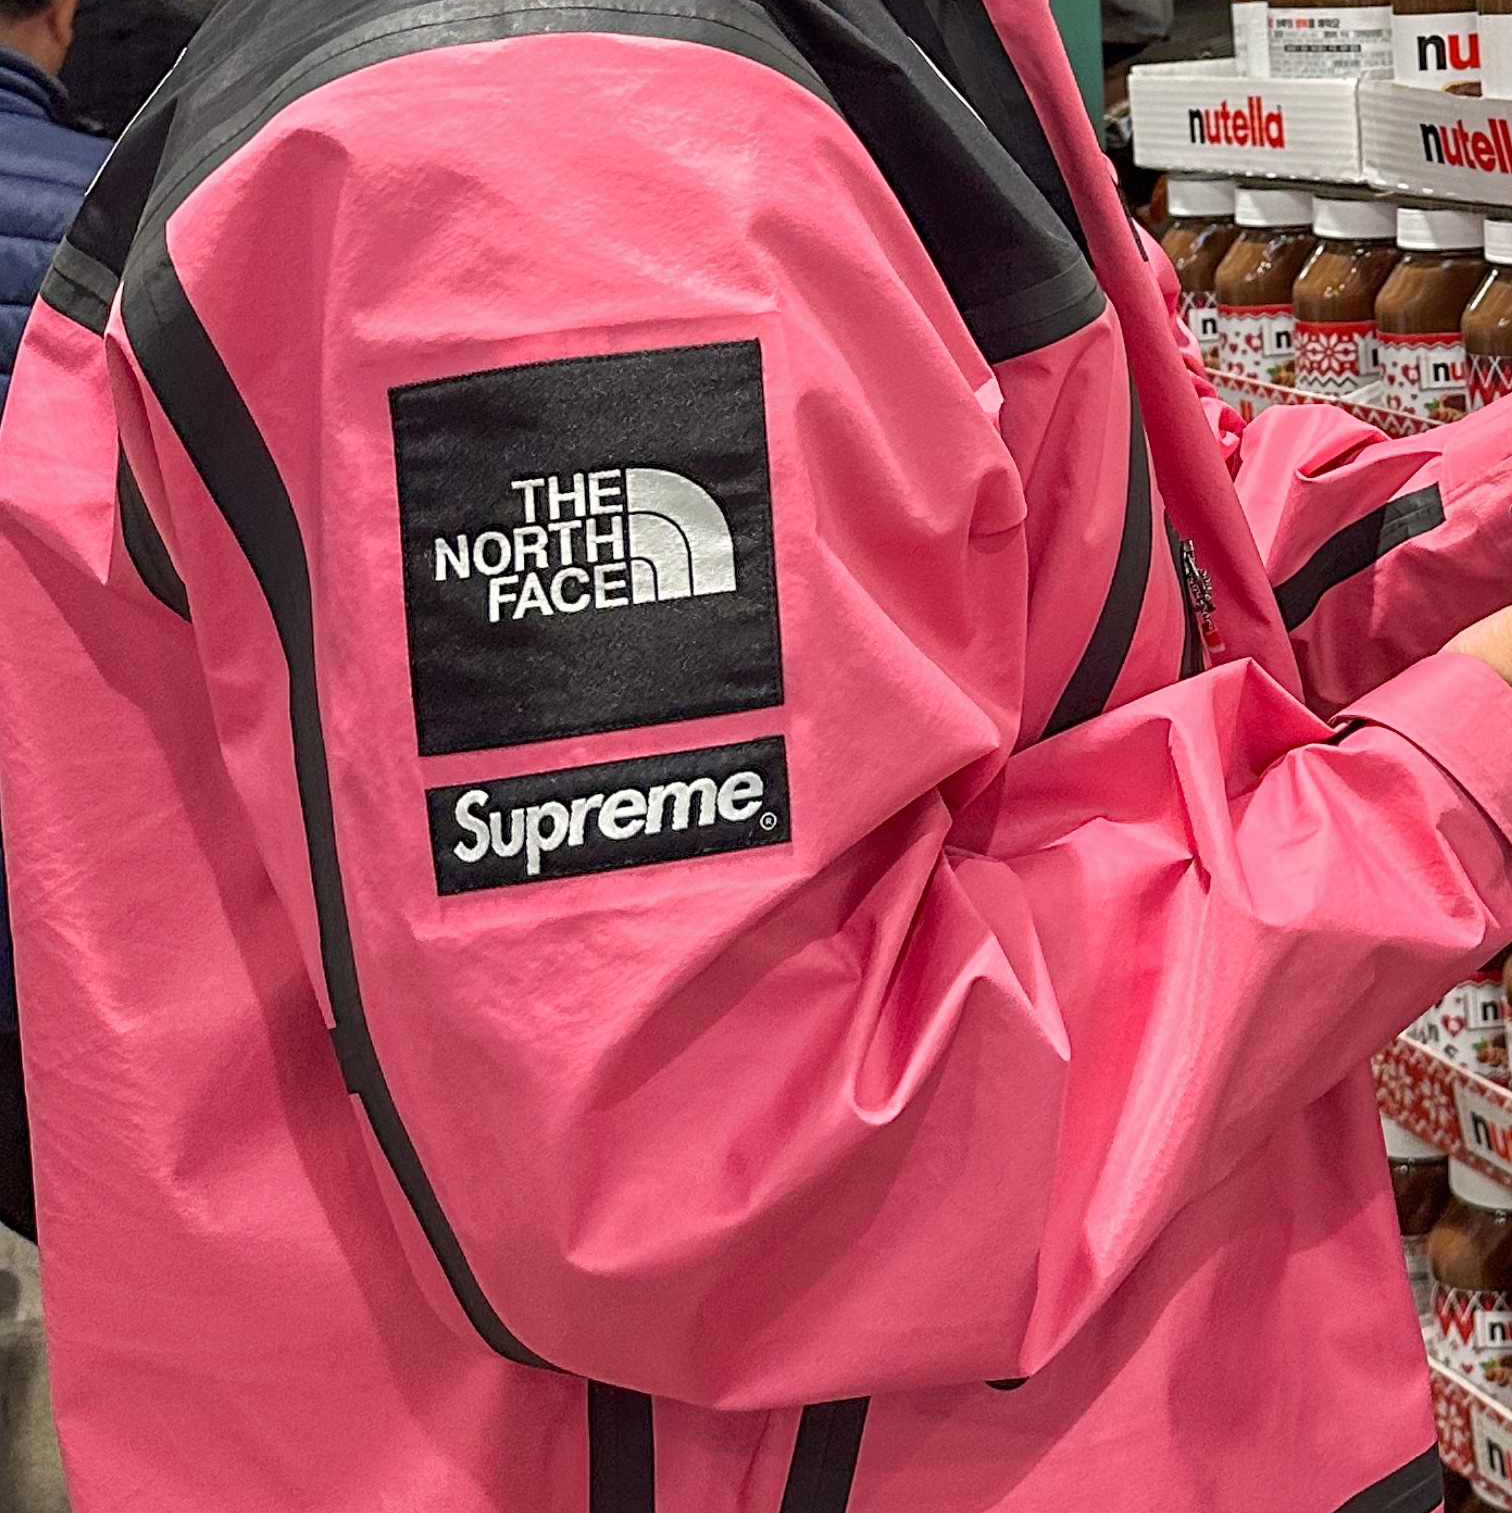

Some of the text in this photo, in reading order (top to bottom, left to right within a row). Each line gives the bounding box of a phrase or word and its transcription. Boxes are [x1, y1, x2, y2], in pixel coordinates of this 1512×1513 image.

[1188, 96, 1286, 149] nutella
[511, 468, 624, 523] THE
[434, 515, 625, 582] NORTH
[488, 562, 629, 623] FACE
[453, 769, 764, 876] Supreme
